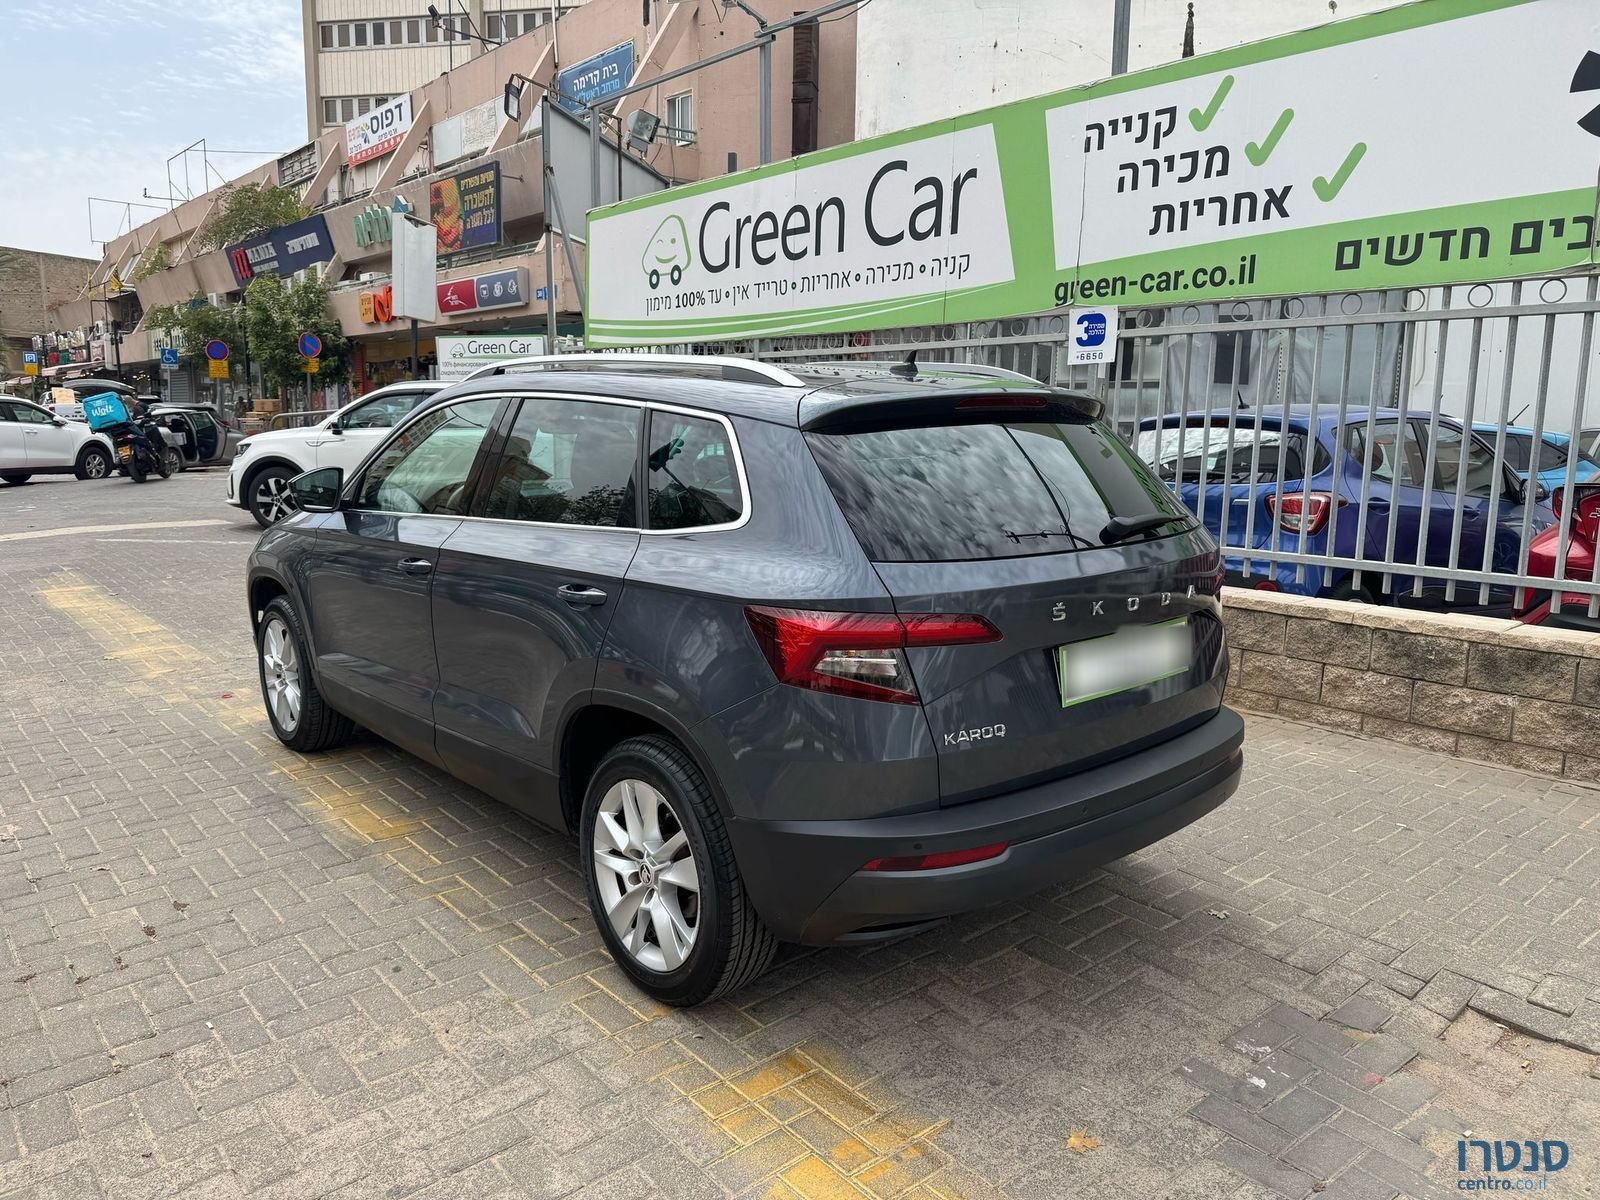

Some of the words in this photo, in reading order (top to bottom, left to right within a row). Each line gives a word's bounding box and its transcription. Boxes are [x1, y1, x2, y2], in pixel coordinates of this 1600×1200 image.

[573, 69, 600, 92] קדימה
[603, 63, 619, 80] בית
[370, 102, 403, 135] דפוס
[1084, 105, 1177, 154] קנייה
[1117, 145, 1230, 193] מכירה
[464, 186, 495, 210] להשכרה
[699, 196, 846, 274] Green
[864, 160, 978, 247] Car
[1149, 184, 1293, 236] אחריות
[1334, 226, 1490, 271] חדשים
[865, 262, 914, 285] מכירה
[930, 253, 971, 279] קניה
[754, 279, 788, 296] טרייד
[800, 270, 852, 294] אחריות
[1054, 254, 1257, 306] green-car.co.il
[645, 295, 672, 316] מימון
[675, 290, 706, 309] 100%
[708, 288, 722, 304] עד
[732, 284, 750, 306] אין
[468, 340, 506, 354] Green
[509, 339, 532, 354] Car
[91, 404, 114, 417] Wolt
[1052, 584, 1197, 622] ŠKODA
[943, 723, 1007, 746] KAROQ
